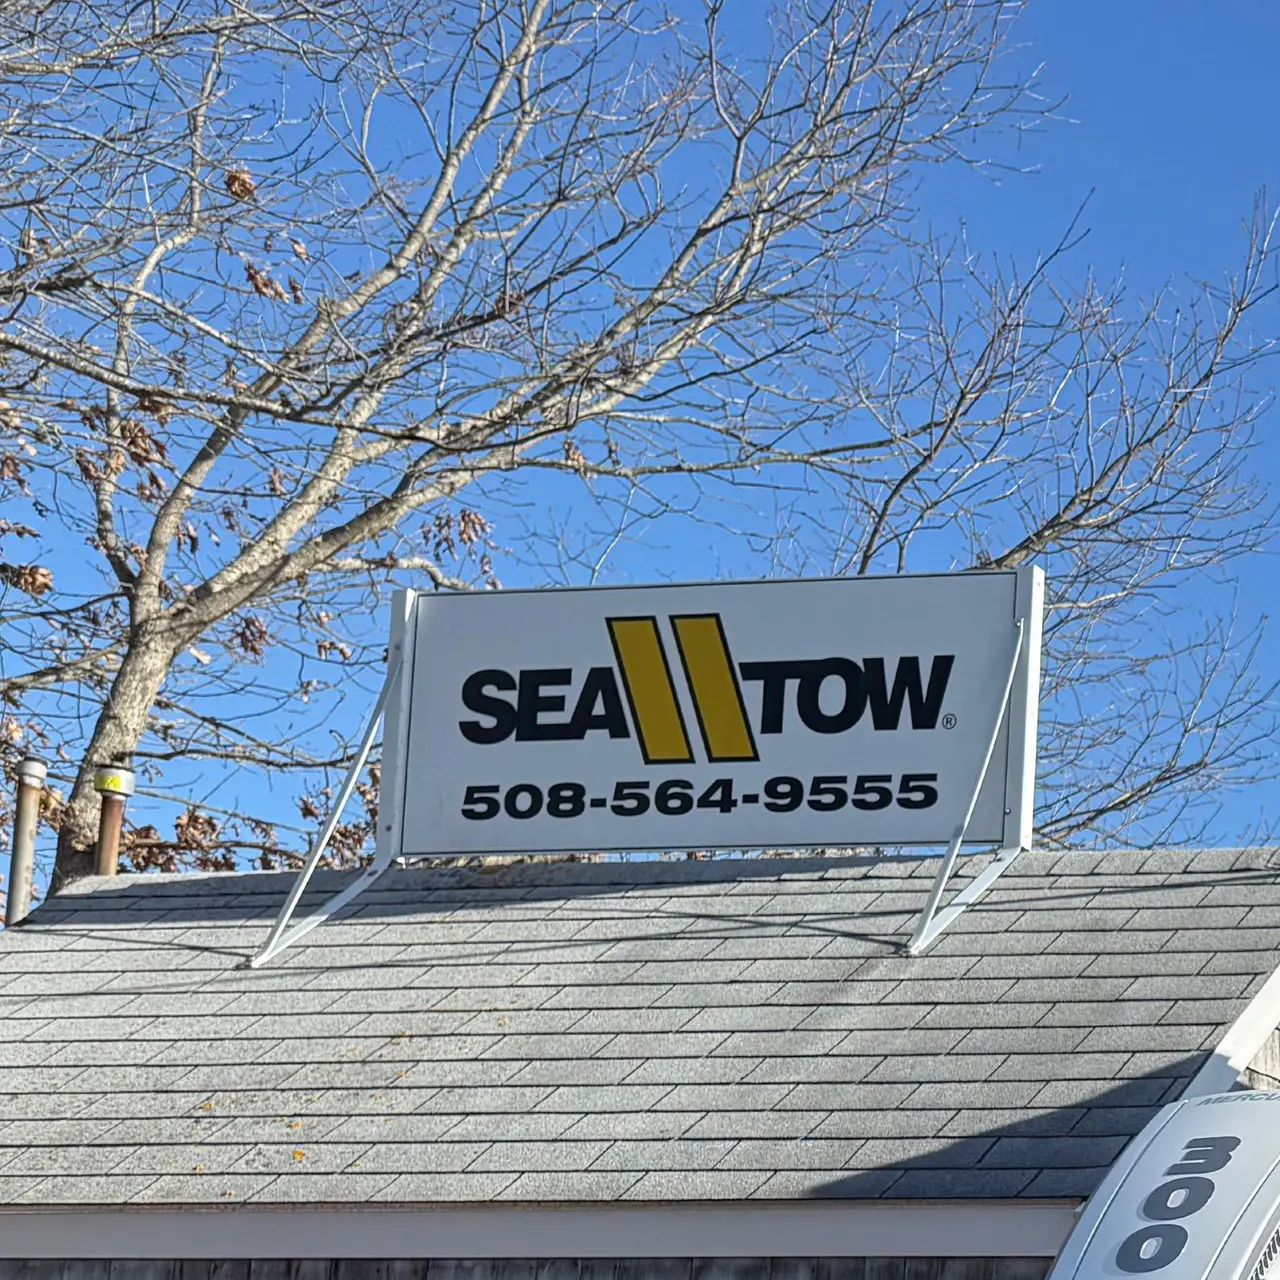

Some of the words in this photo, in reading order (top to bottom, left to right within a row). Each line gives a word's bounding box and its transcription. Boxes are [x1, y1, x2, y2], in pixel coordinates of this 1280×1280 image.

[459, 667, 631, 745] SEA
[461, 772, 939, 821] 508-564-9555
[1115, 1136, 1241, 1273] 300
